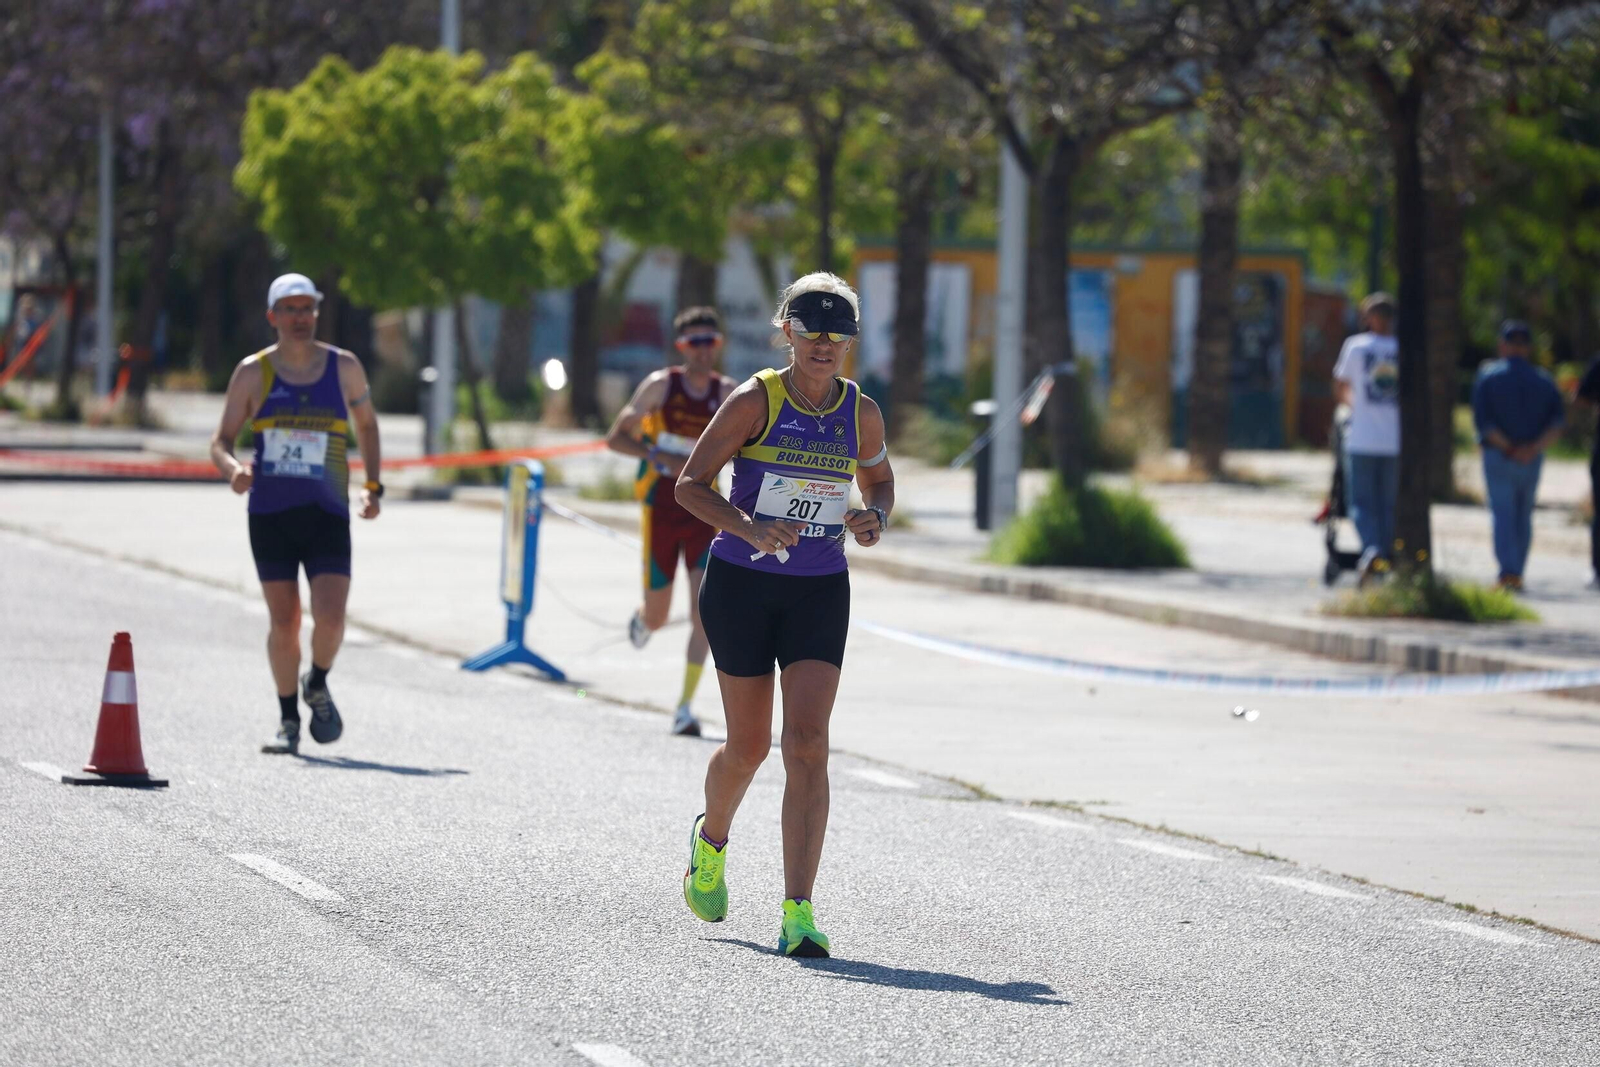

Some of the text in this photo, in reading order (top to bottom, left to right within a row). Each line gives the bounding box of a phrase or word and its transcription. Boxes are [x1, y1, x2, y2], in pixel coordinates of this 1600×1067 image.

[780, 423, 806, 432] MERCURY
[281, 444, 303, 460] 24
[778, 435, 849, 456] ELS SITGES
[776, 451, 851, 470] BURJASSOT
[786, 498, 823, 521] 207
